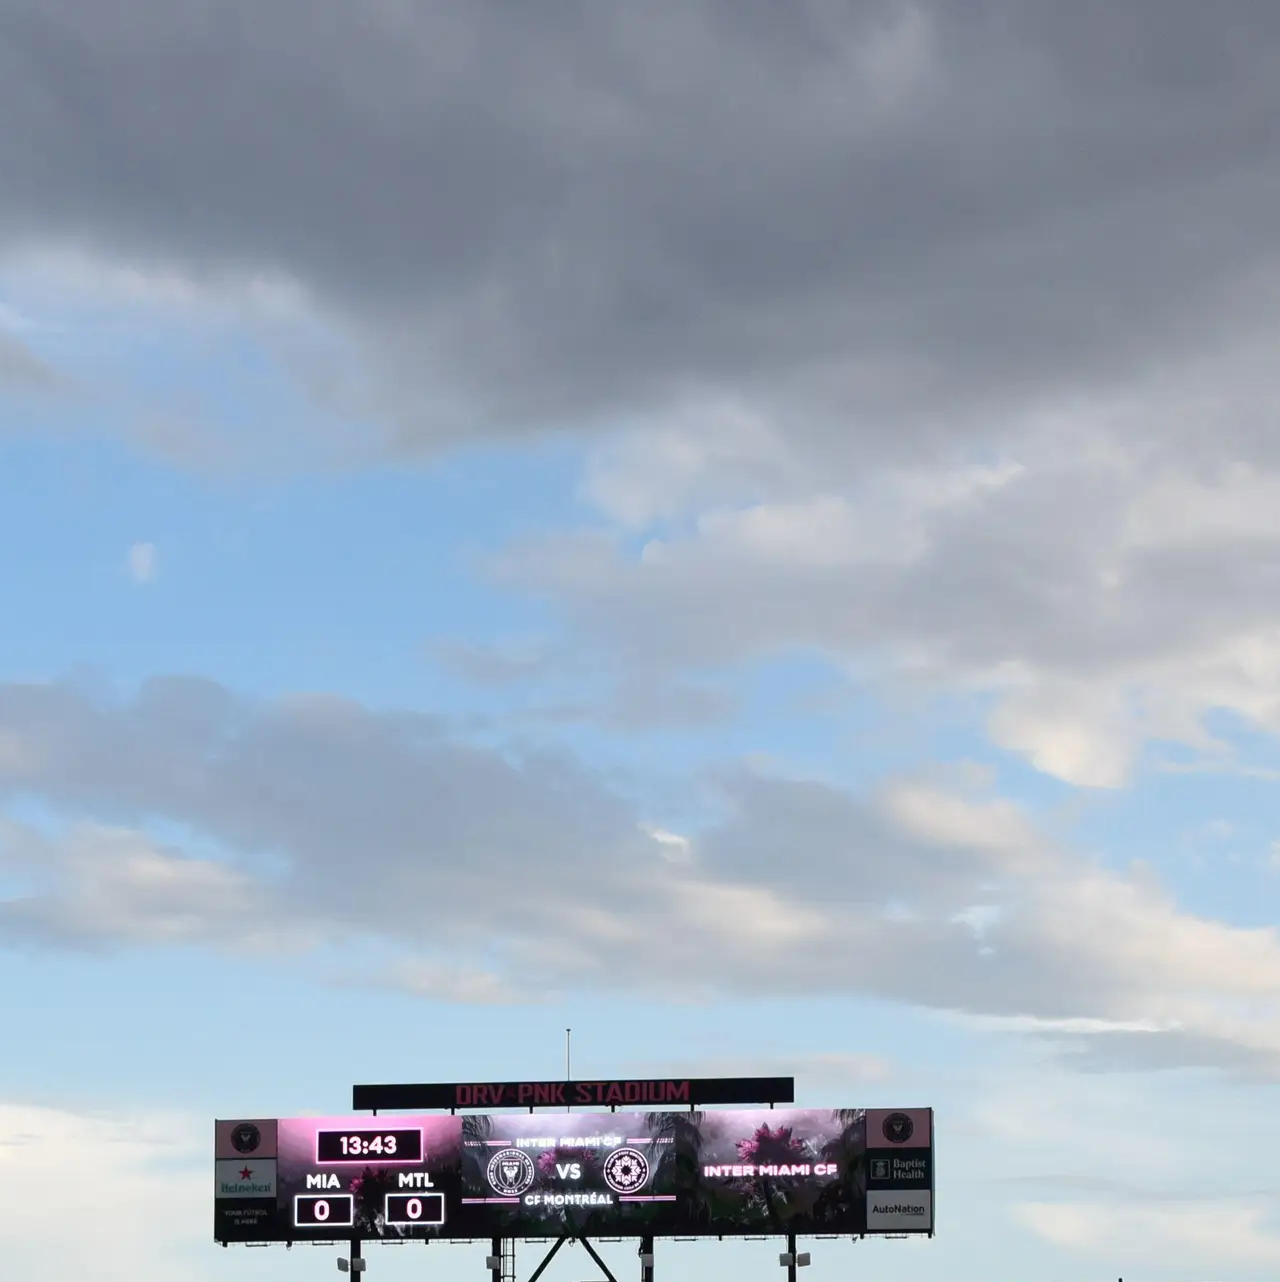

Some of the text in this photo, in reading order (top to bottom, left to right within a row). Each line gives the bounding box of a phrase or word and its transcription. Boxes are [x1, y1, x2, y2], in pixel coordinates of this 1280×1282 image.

[456, 1081, 690, 1105] DRV PNK STADIUM
[340, 1136, 397, 1154] 13:43
[516, 1138, 556, 1148] INTER
[560, 1137, 601, 1147] MIAMI
[704, 1164, 838, 1178] INTER MIAMI CF
[893, 1159, 926, 1170] Baptist
[556, 1164, 581, 1180] VS
[893, 1170, 924, 1179] Health
[306, 1174, 340, 1189] MIA
[398, 1173, 434, 1188] MTL
[221, 1182, 271, 1194] Heineken
[524, 1192, 613, 1206] CF MONTRÉAL
[314, 1201, 330, 1221] 0
[406, 1199, 422, 1219] 0
[872, 1204, 925, 1214] AutoNation
